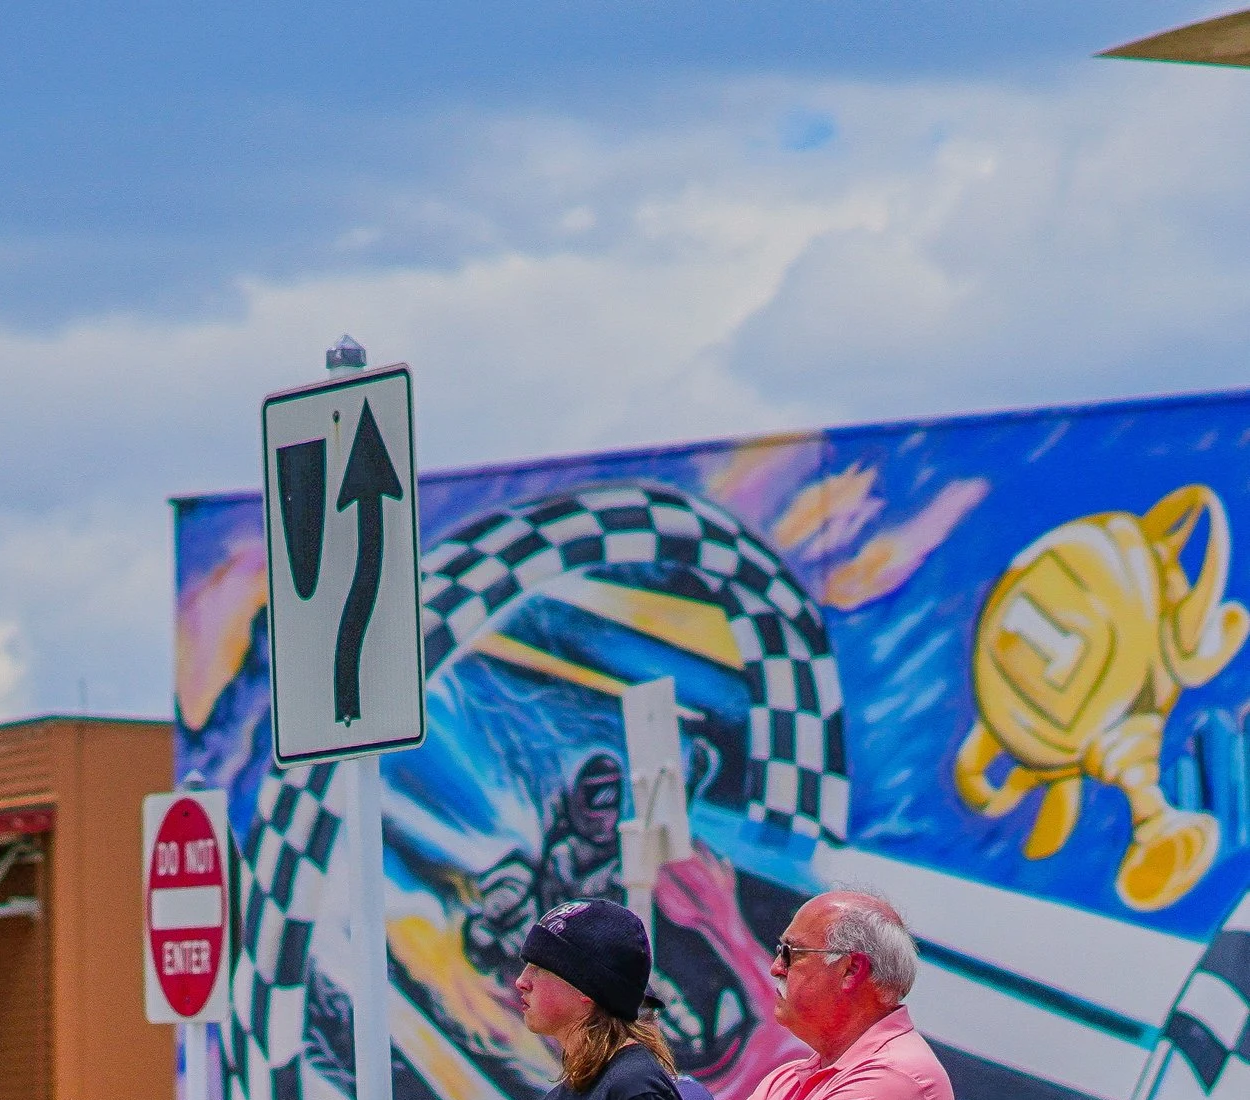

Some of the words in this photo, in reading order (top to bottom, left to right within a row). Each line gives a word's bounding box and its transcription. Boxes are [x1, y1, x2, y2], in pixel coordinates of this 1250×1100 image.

[156, 841, 180, 876] DO
[184, 838, 214, 875] NOT
[162, 940, 212, 976] ENTER
